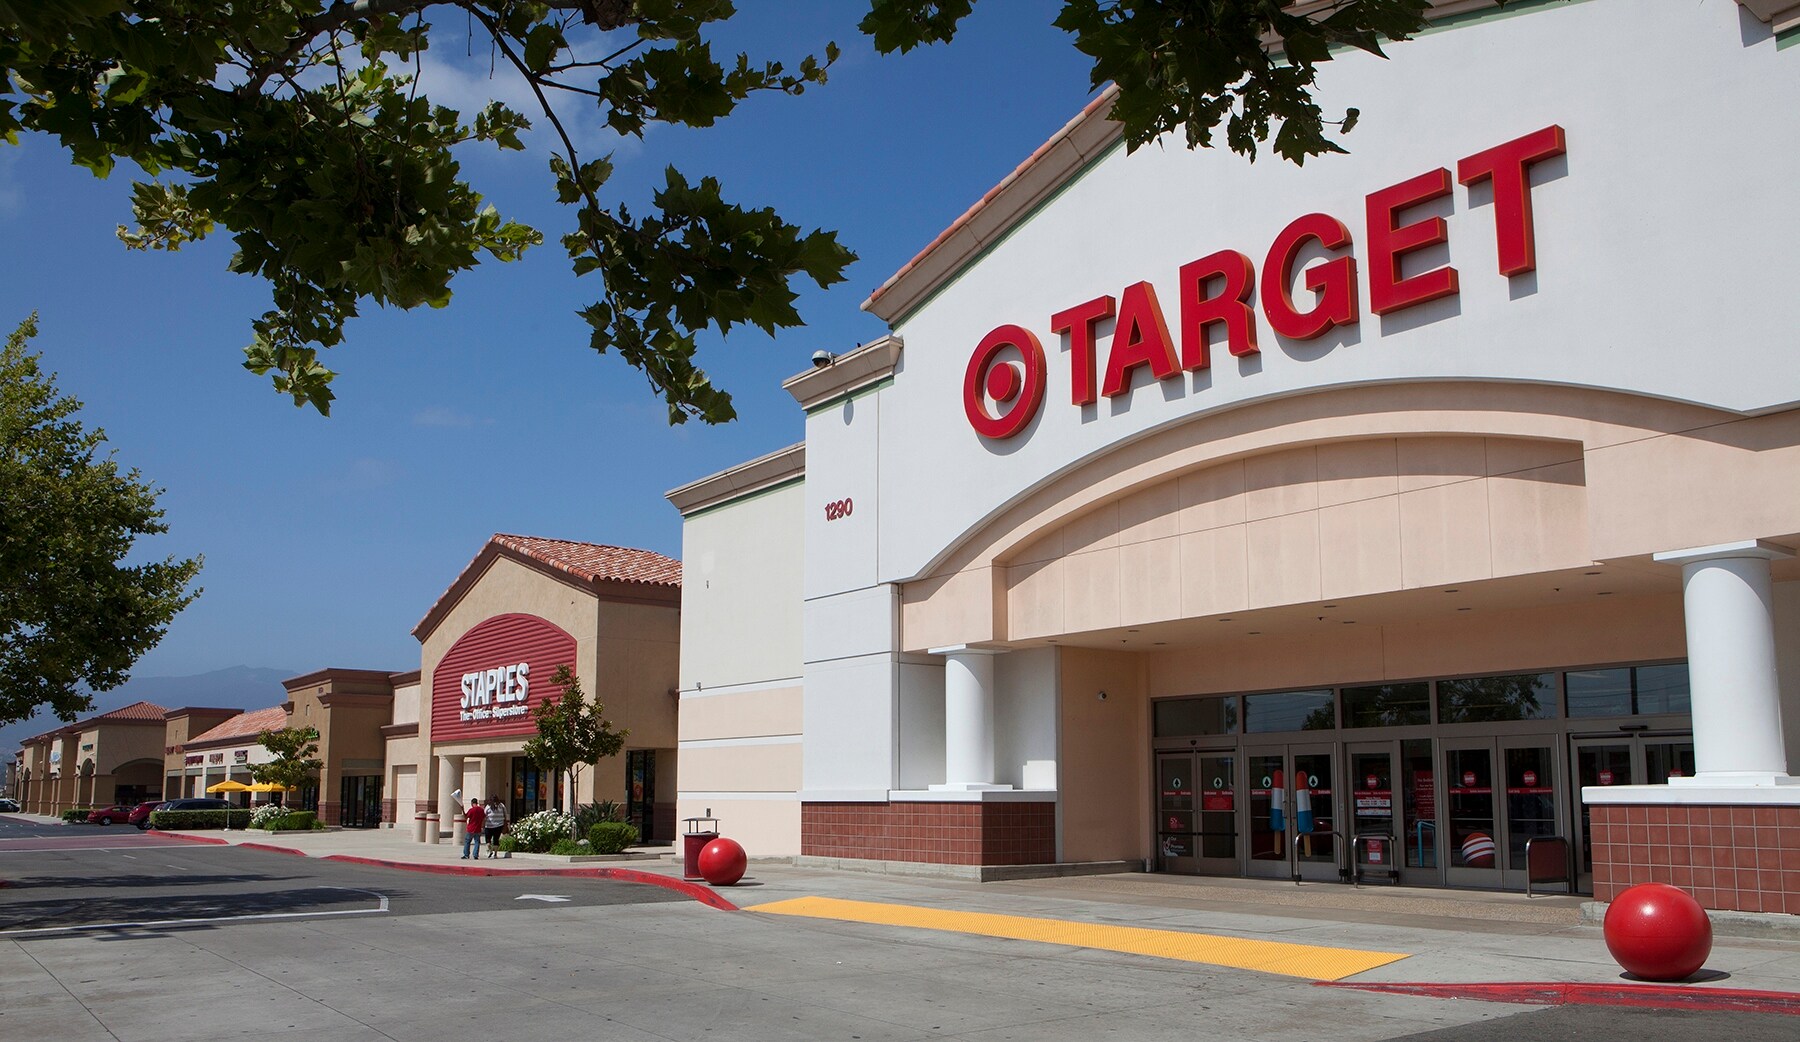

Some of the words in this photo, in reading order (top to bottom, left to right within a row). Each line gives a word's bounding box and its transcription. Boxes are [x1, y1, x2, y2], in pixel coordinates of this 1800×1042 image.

[1050, 123, 1566, 407] TARGET
[824, 497, 853, 522] 1290
[460, 662, 530, 709] STAPLES
[460, 710, 473, 722] The
[473, 708, 492, 720] Office
[492, 704, 529, 719] Superstore
